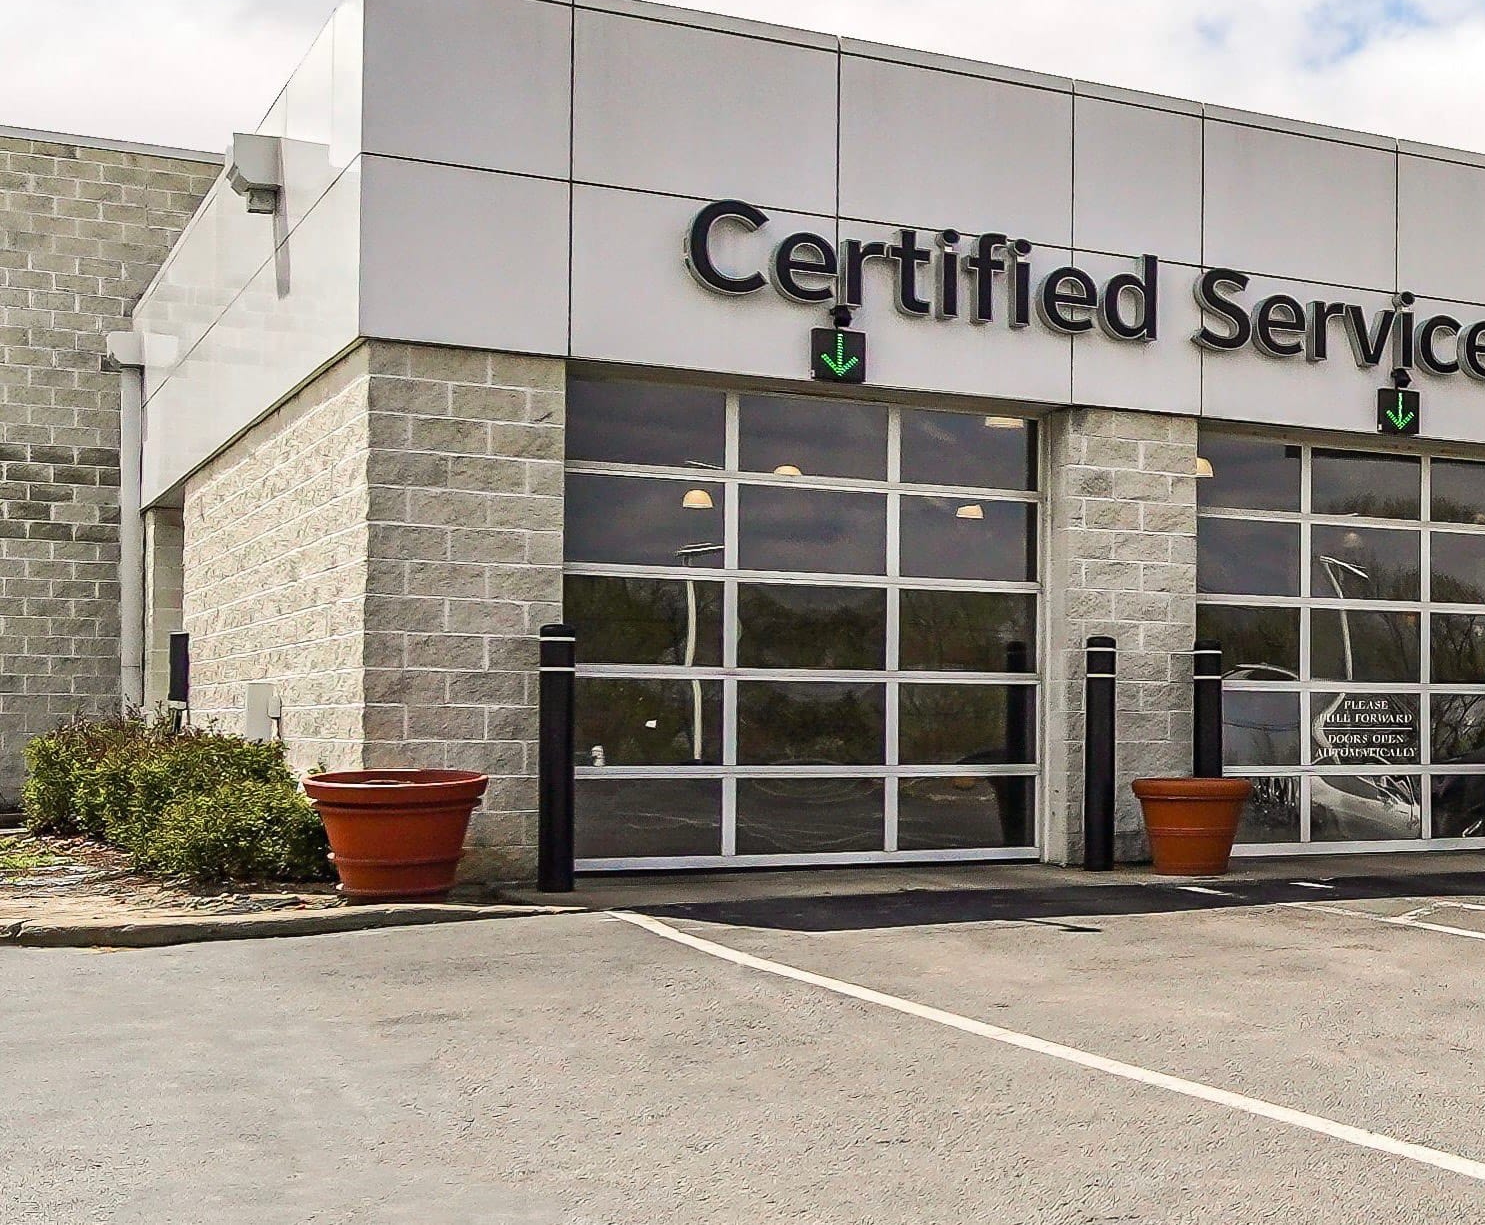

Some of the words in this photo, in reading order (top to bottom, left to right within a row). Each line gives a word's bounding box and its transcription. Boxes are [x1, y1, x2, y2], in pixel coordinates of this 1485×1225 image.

[684, 199, 1158, 342] Certified
[1344, 700, 1389, 710] PLEASE
[1355, 713, 1413, 723] FORWARD
[1328, 734, 1368, 744] DOORS
[1372, 734, 1404, 744] OPEN
[1316, 747, 1417, 758] AUTOMATICALLY
